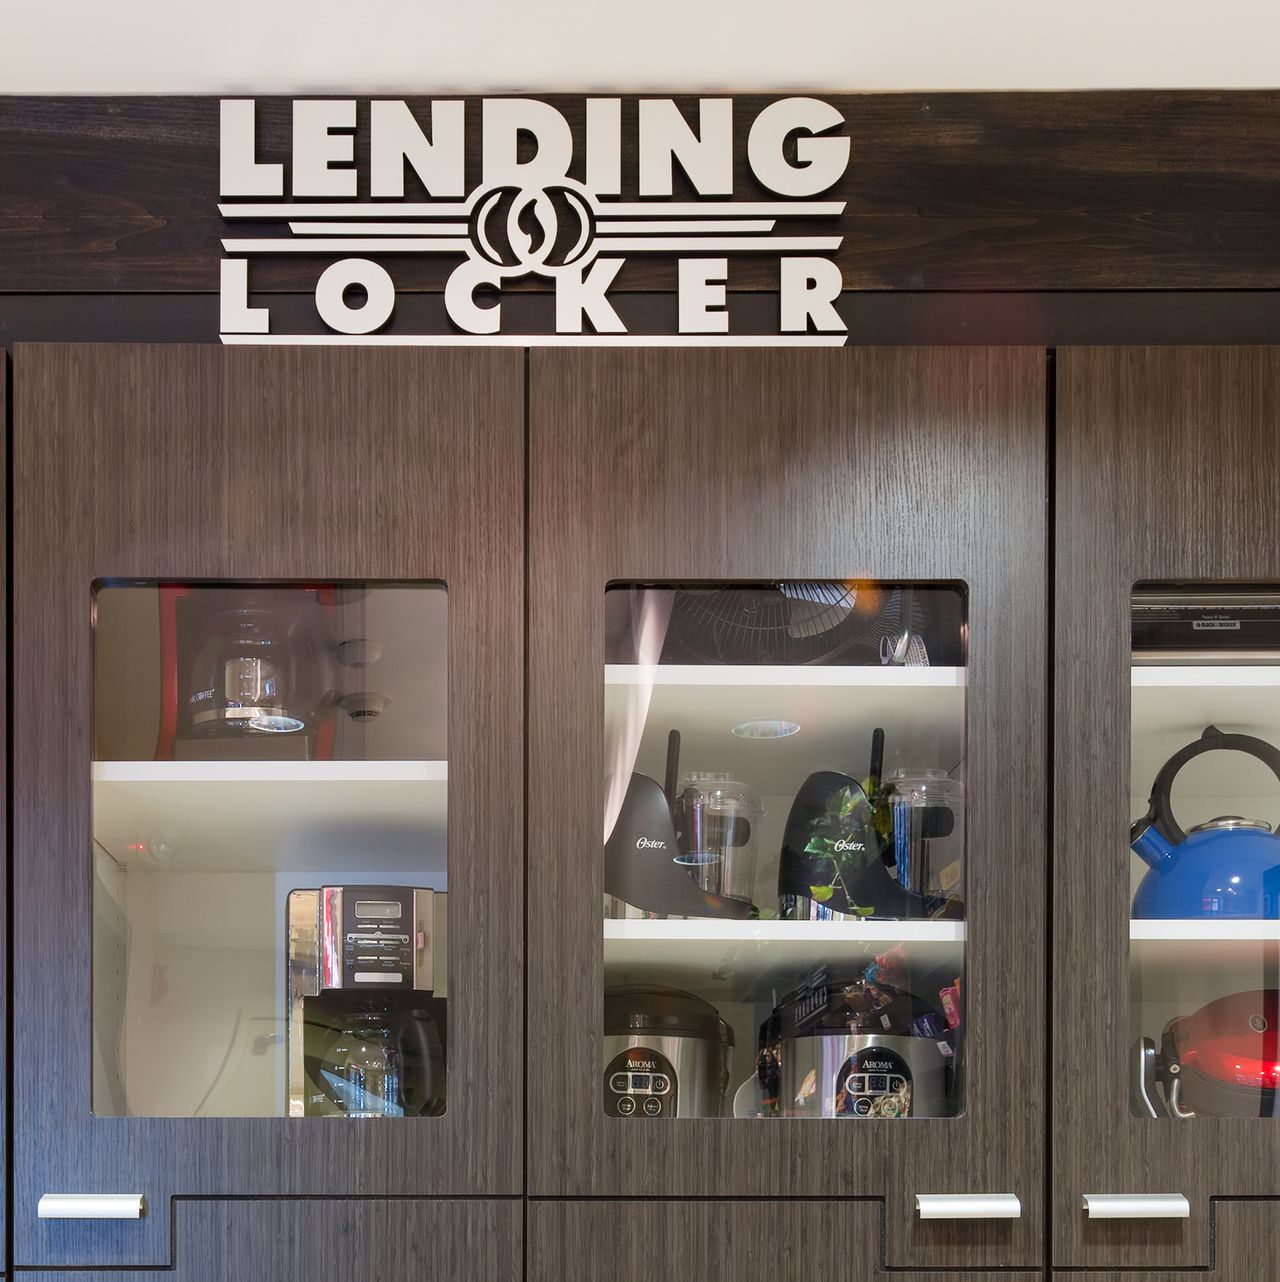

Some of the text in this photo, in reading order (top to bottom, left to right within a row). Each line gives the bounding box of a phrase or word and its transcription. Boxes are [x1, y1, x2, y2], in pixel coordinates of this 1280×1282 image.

[219, 97, 851, 197] LENDING
[219, 257, 848, 334] LOCKER
[636, 837, 666, 849] Oster
[834, 839, 865, 851] Oster
[626, 1059, 656, 1068] AROMA
[862, 1060, 893, 1069] AROMA
